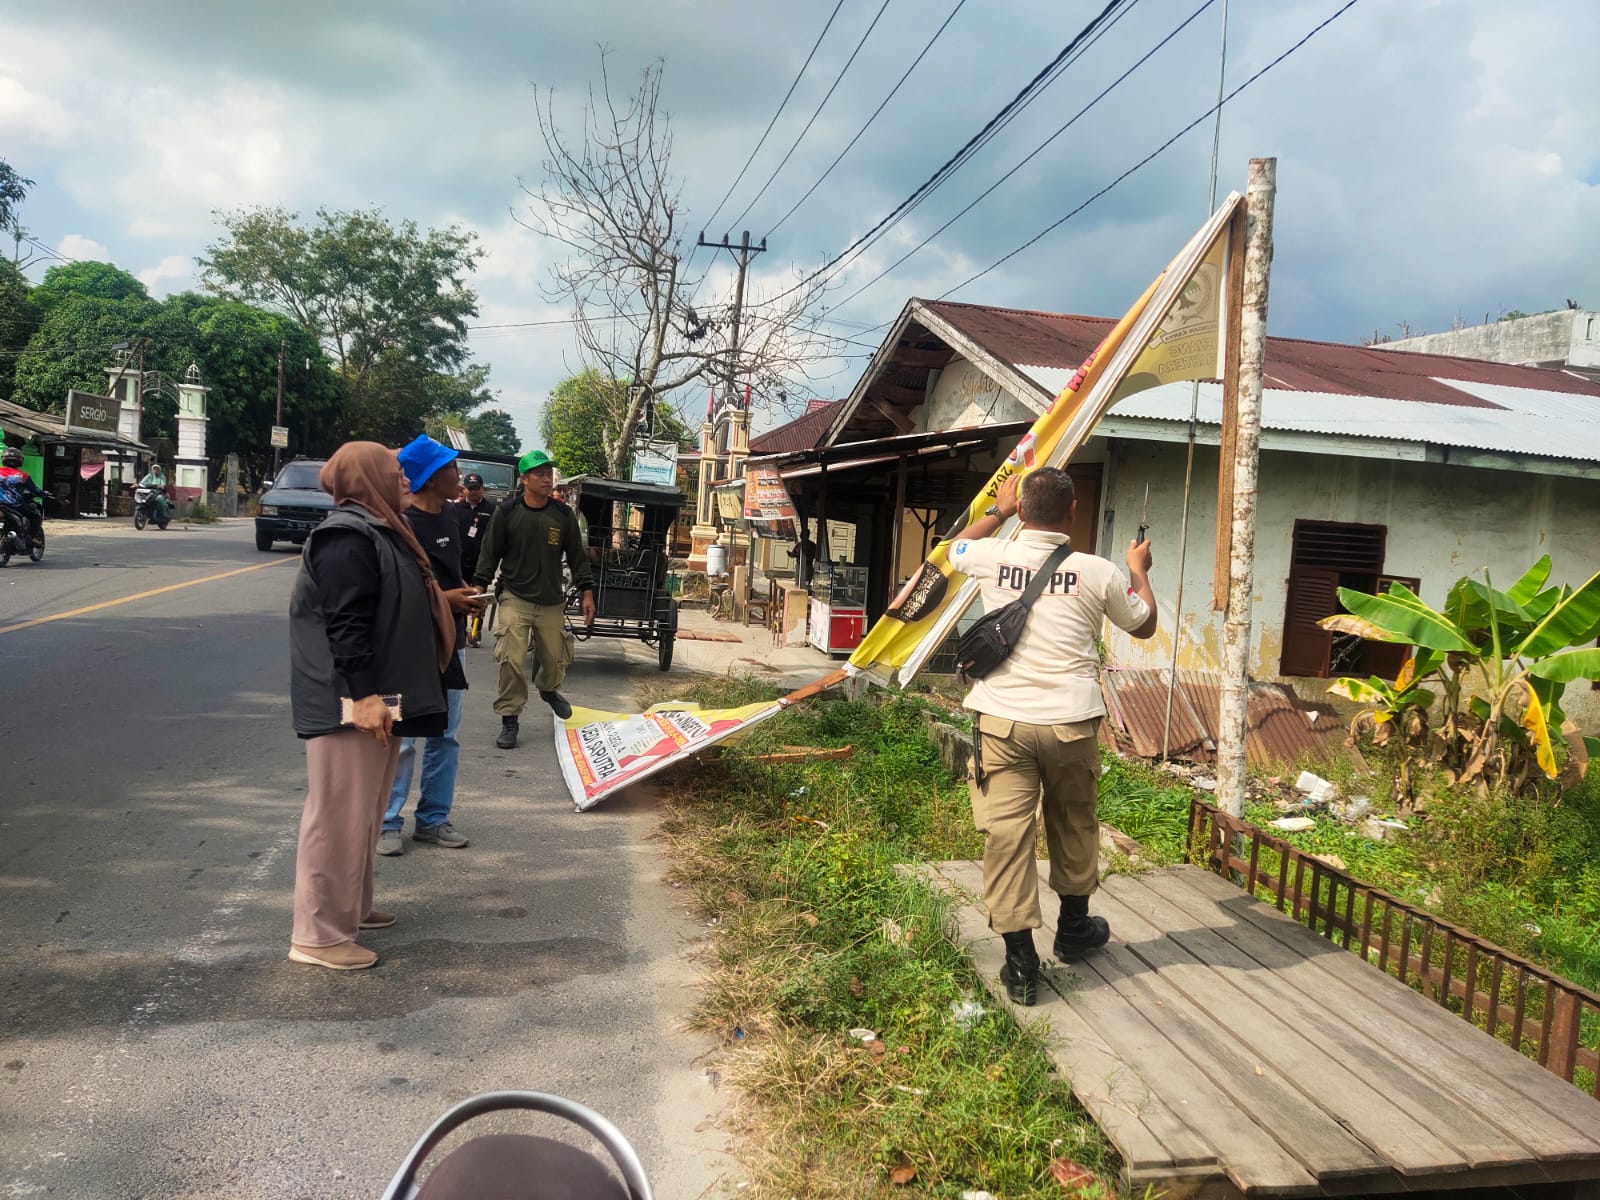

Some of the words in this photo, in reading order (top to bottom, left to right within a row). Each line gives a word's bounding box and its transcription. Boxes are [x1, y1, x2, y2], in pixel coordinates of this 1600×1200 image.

[80, 405, 107, 422] SERGIO
[1050, 571, 1078, 594] PP
[587, 740, 616, 780] SAPUTRA
